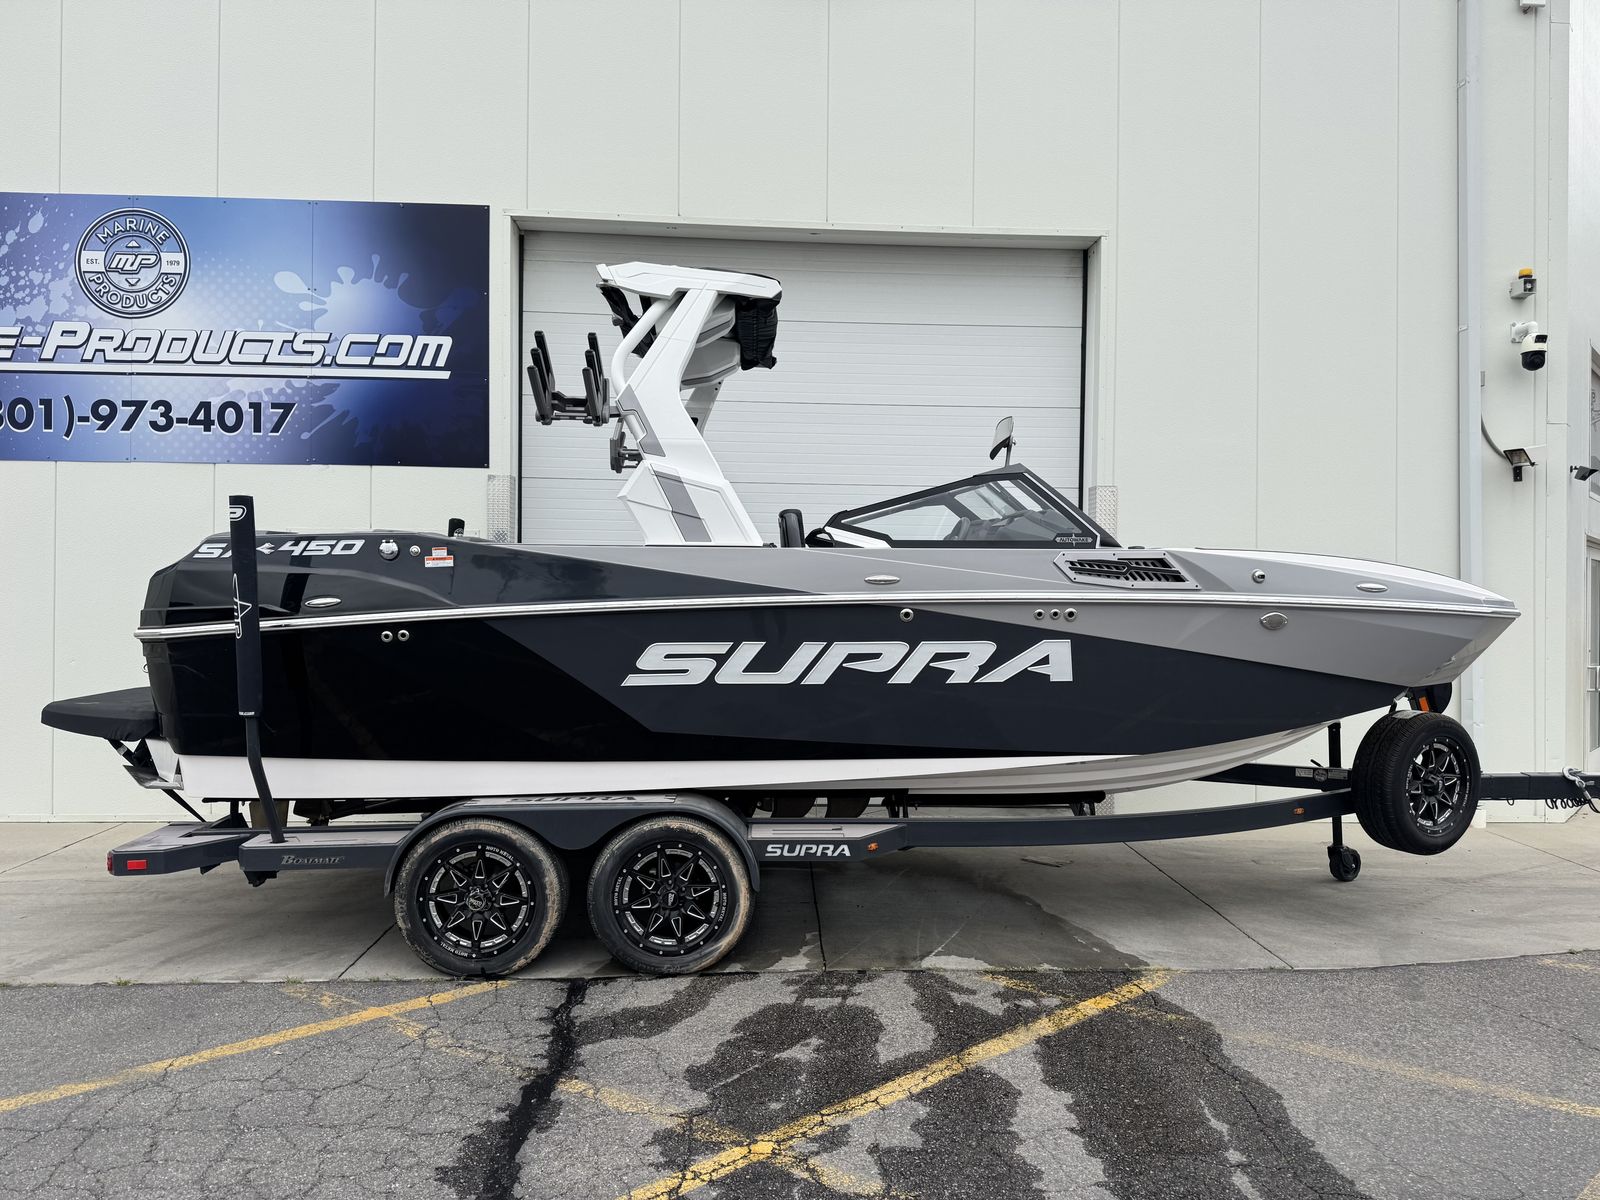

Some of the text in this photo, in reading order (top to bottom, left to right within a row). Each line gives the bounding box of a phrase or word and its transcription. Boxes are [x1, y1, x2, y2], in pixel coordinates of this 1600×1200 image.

[96, 218, 171, 245] MARINE
[90, 273, 177, 308] PRODUCTS
[0, 395, 297, 440] 01)-973-4017
[192, 539, 366, 559] S 450
[620, 639, 1074, 687] SUPRA
[765, 843, 852, 857] SUPRA
